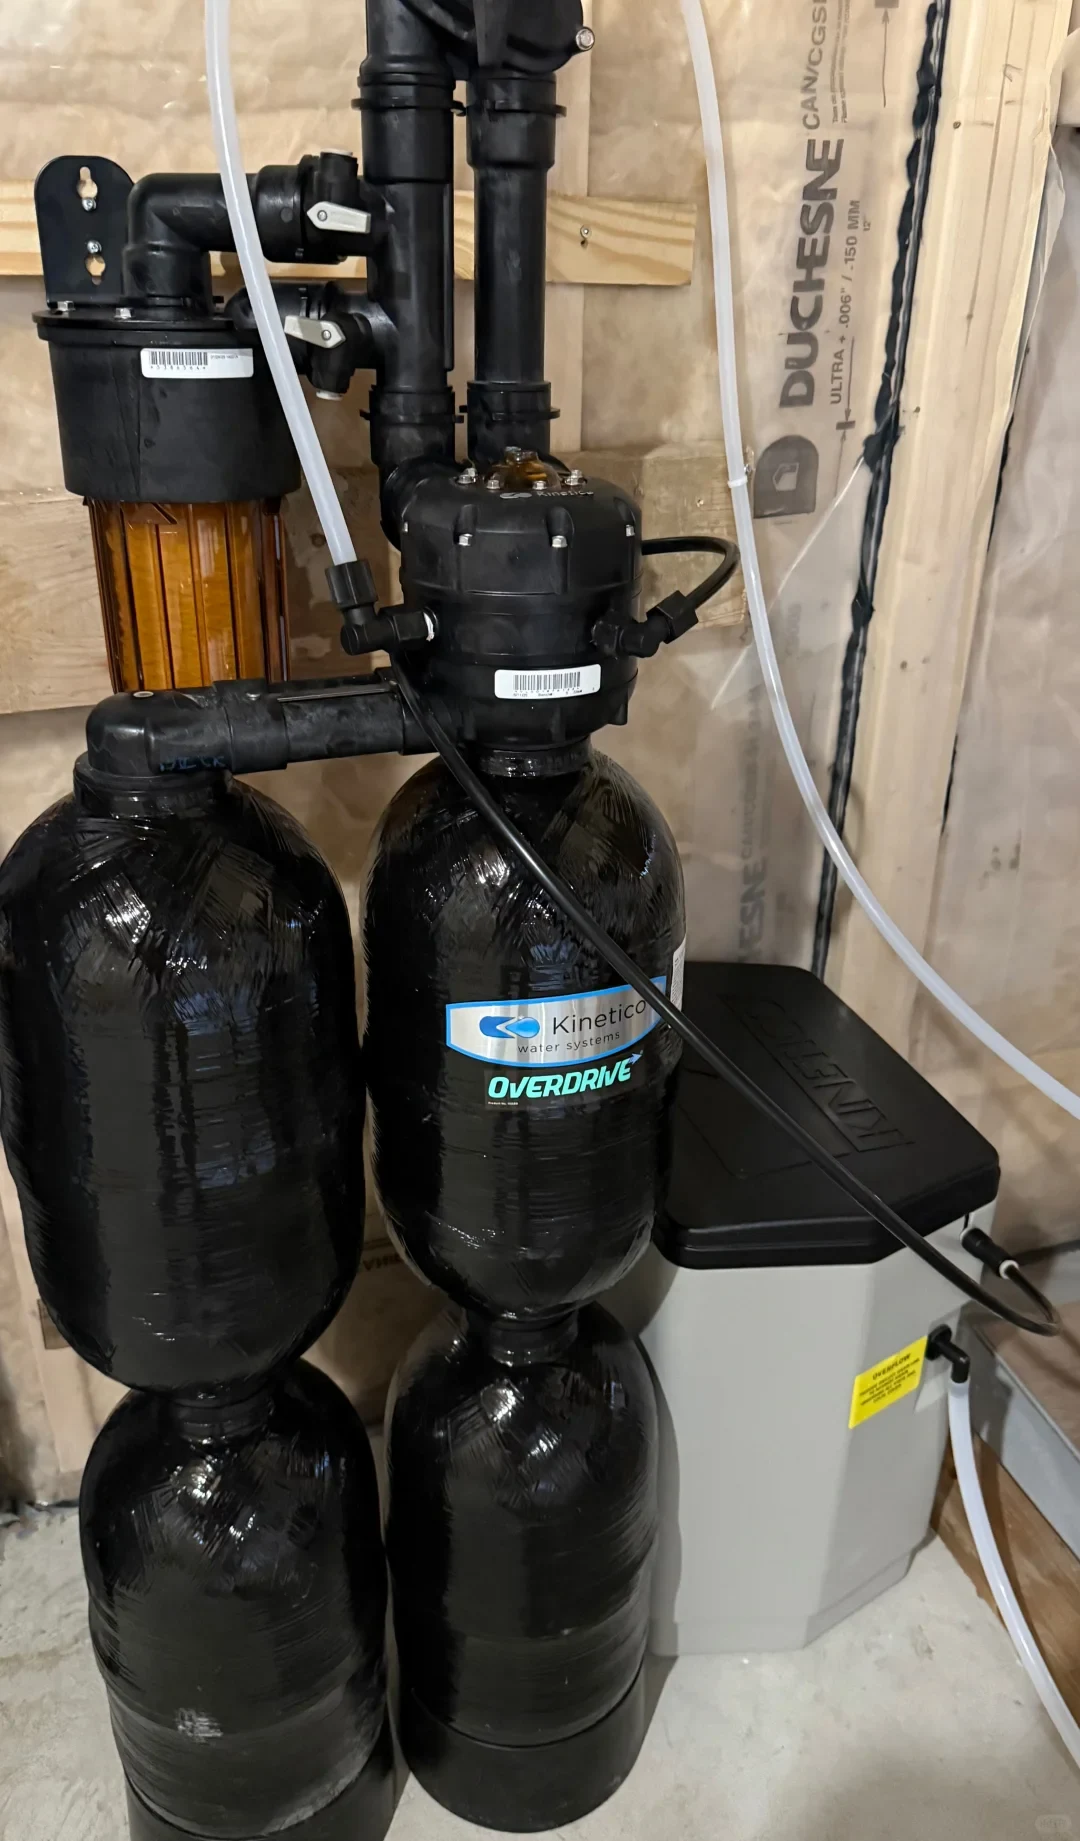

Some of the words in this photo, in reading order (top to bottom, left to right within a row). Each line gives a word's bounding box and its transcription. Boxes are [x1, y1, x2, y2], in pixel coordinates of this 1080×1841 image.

[801, 0, 827, 130] CAN/CGS
[847, 199, 861, 230] MM
[779, 138, 844, 408] DUCHESNE
[844, 235, 858, 271] .150
[839, 287, 852, 329] .006"
[830, 348, 845, 405] ULTRA
[553, 999, 647, 1035] Kinetico
[517, 1043, 560, 1053] water
[566, 1031, 621, 1051] systems
[487, 1058, 632, 1099] OVERDRIVE
